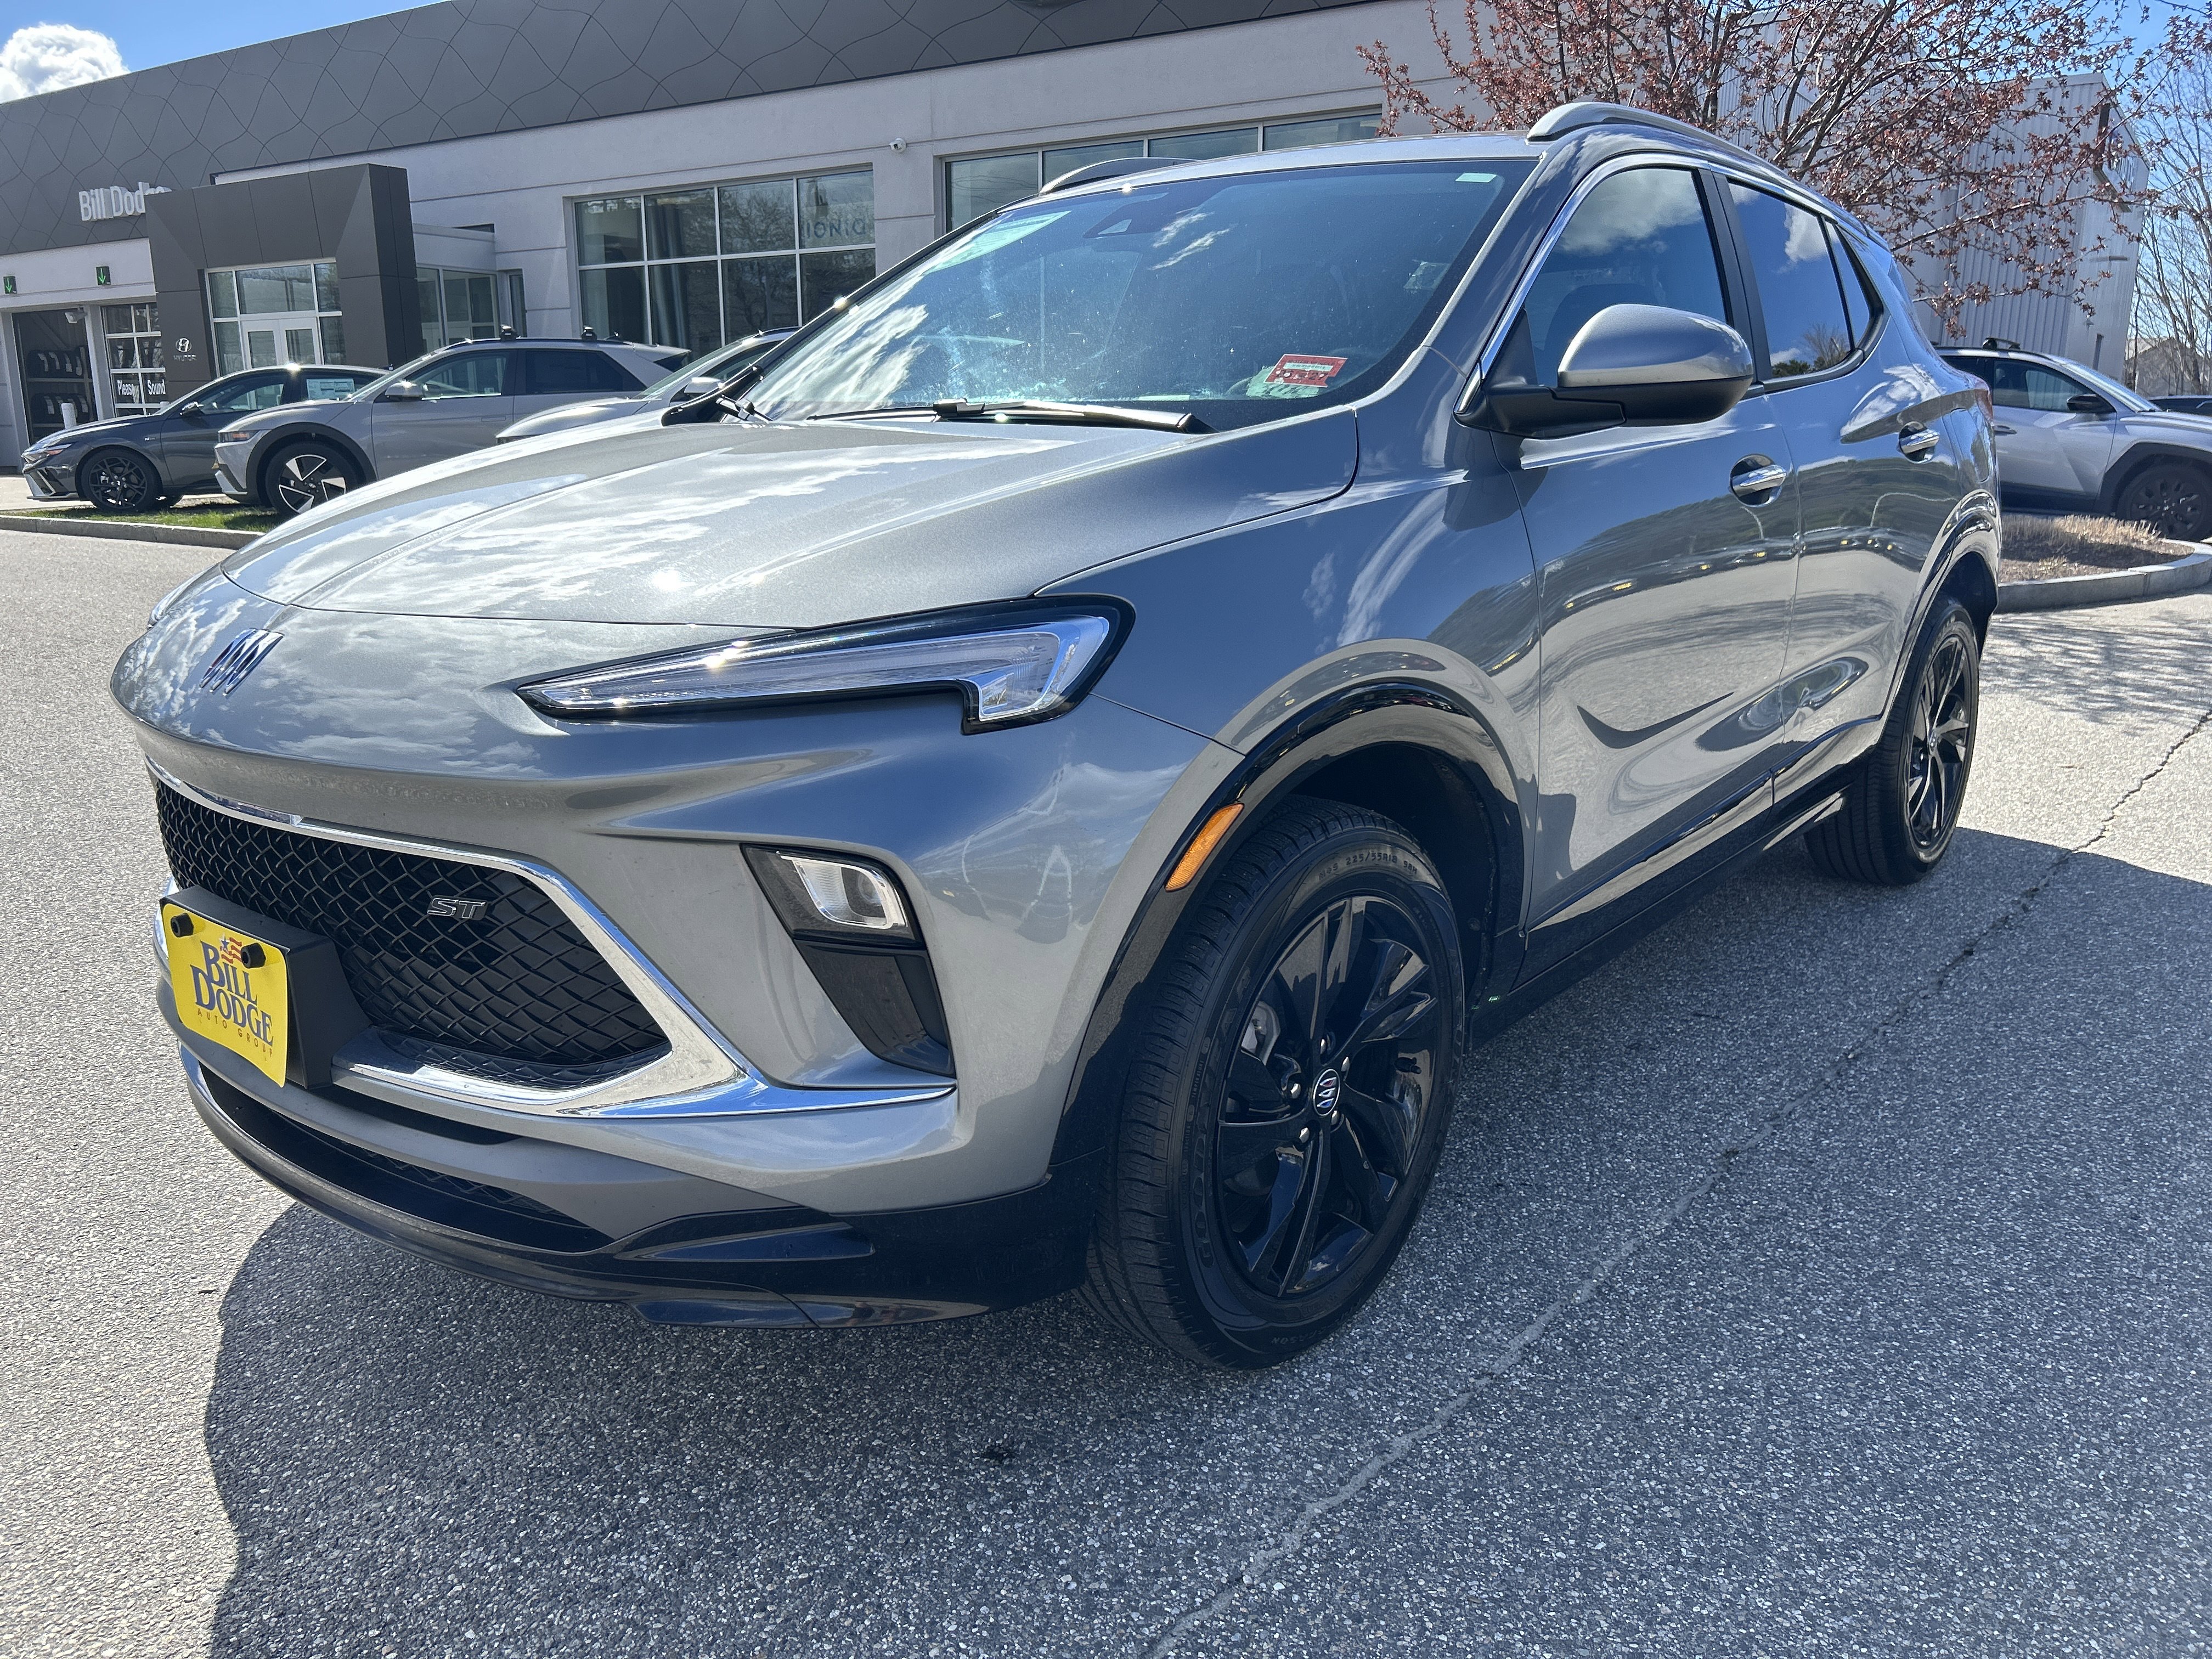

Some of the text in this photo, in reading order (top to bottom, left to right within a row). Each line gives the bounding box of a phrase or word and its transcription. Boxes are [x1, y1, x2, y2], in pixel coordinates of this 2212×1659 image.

[79, 182, 172, 221] Bill Dod
[147, 379, 166, 396] Sound
[1345, 851, 1397, 865] 225/55R18
[1403, 860, 1418, 874] 98H
[427, 898, 486, 919] ST
[200, 940, 258, 1006] BILL
[190, 964, 274, 1047] DODGE
[198, 1008, 273, 1058] AUTO GROUP
